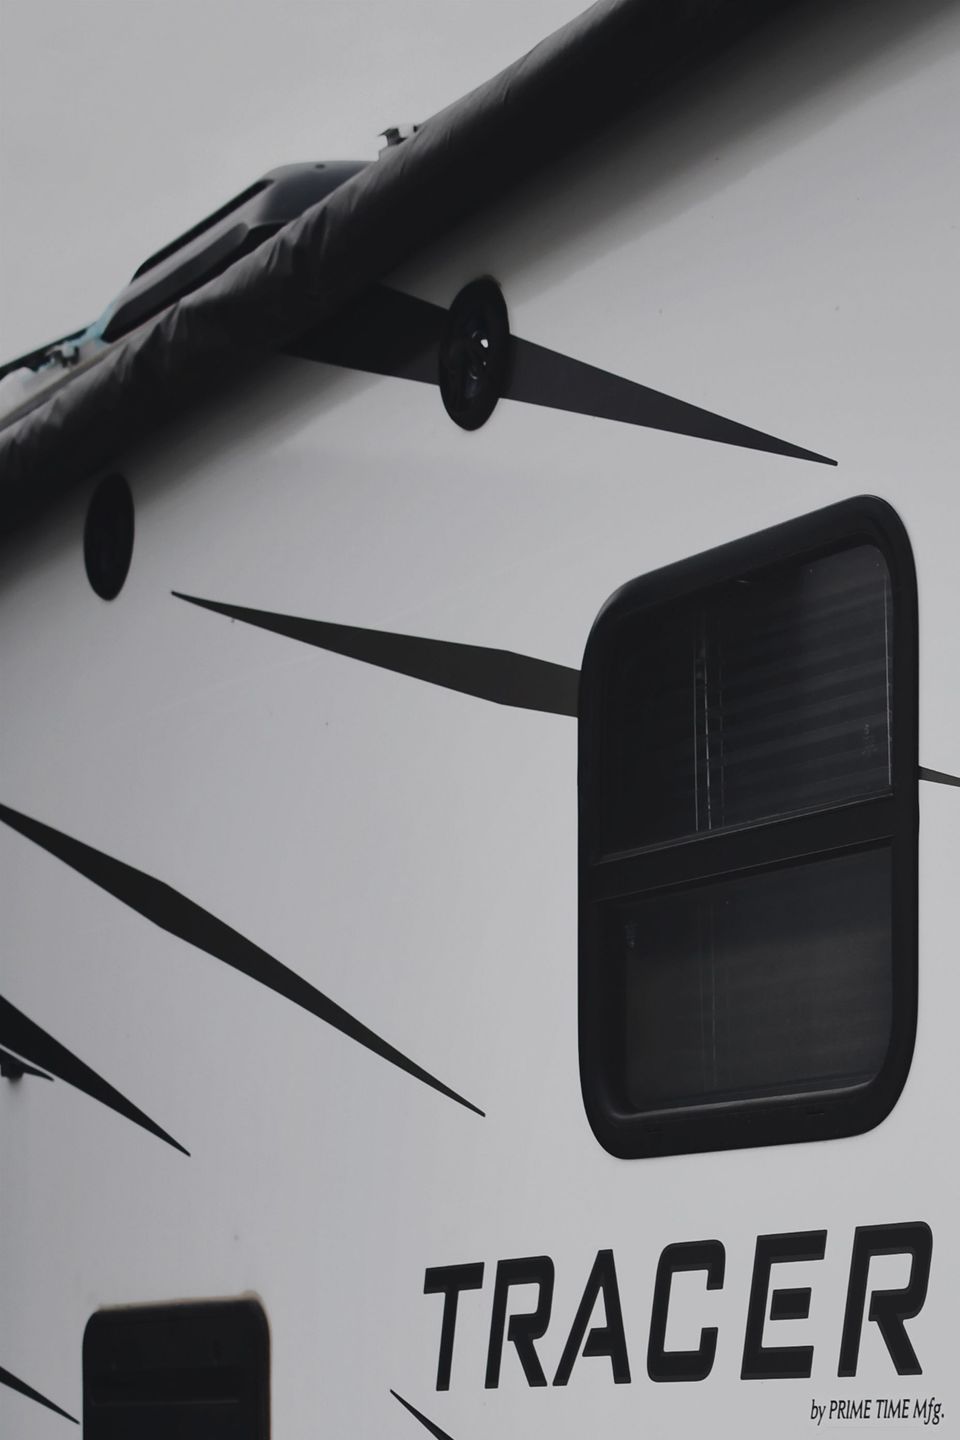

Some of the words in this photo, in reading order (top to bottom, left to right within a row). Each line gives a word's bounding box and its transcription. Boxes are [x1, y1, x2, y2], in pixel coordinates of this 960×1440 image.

[423, 1221, 933, 1391] TRACER
[810, 1400, 827, 1425] by
[828, 1400, 871, 1420] PRIME
[875, 1399, 910, 1419] TIME
[913, 1399, 945, 1424] Mfg.
